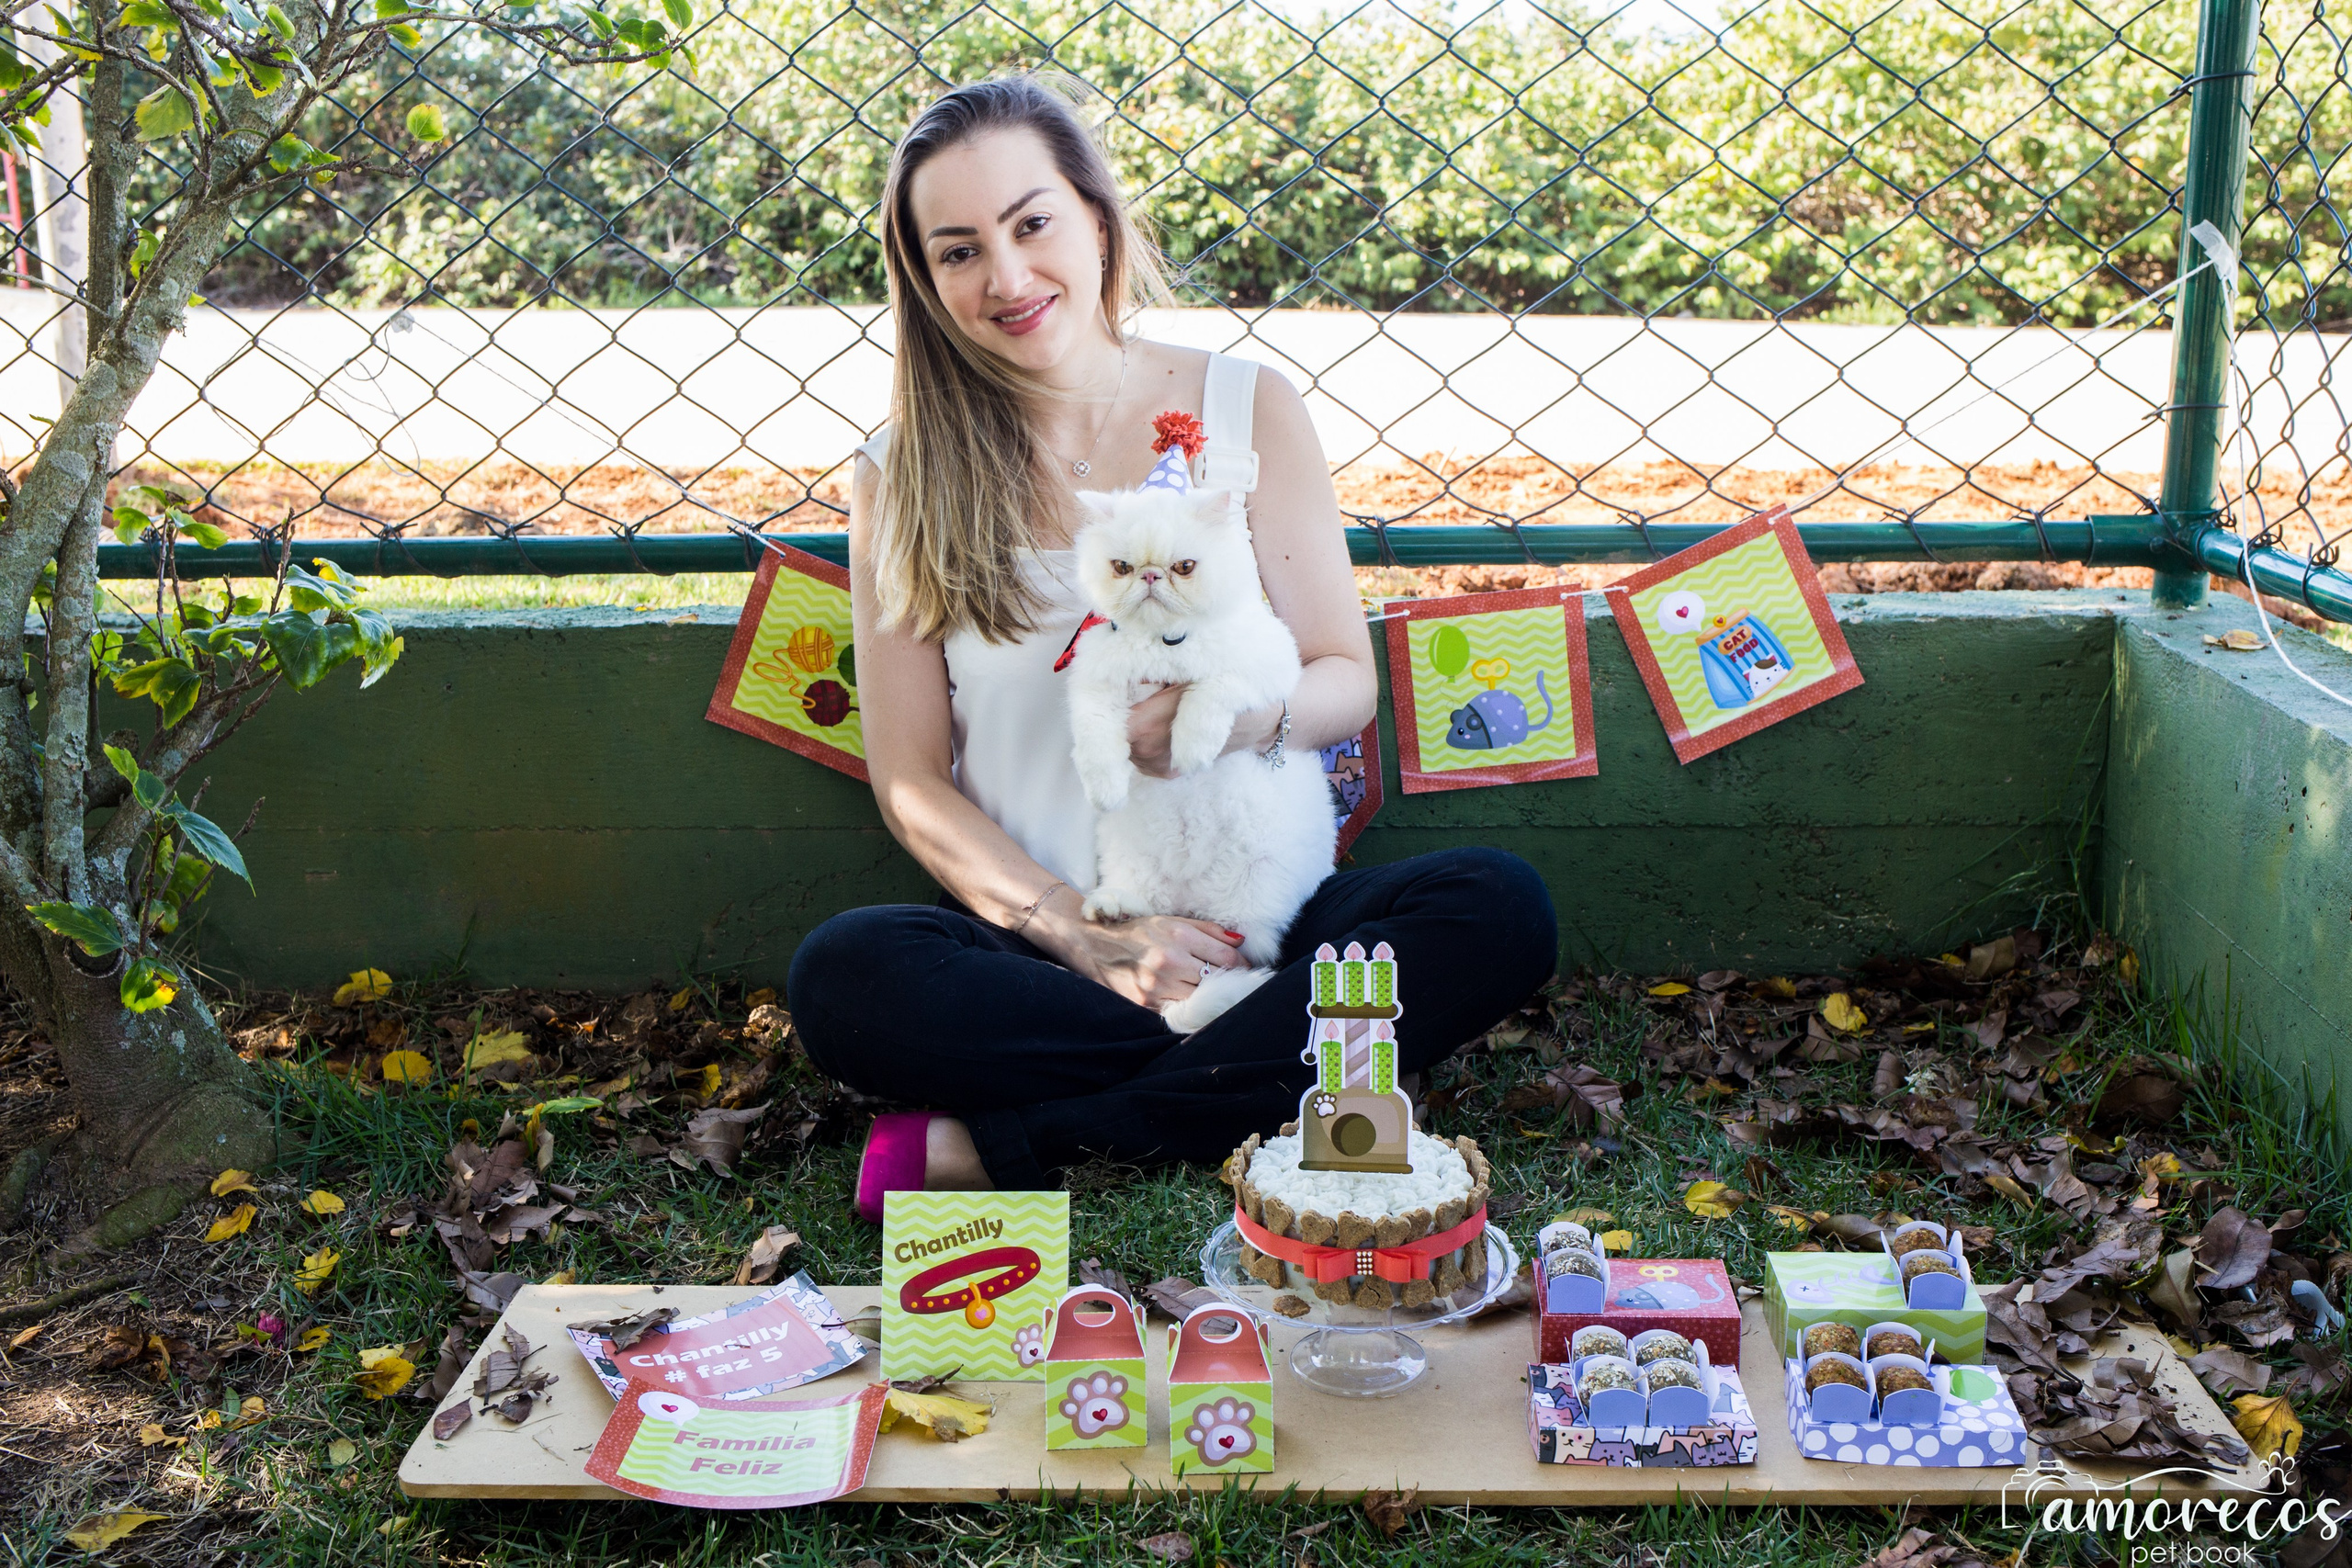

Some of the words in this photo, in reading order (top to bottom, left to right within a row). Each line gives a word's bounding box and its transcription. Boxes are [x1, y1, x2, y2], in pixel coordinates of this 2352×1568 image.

[1724, 629, 1747, 651] CAT
[1730, 638, 1759, 663] FOOD
[894, 1217, 1003, 1264] Chantilly
[629, 1320, 789, 1368] Chantilly
[664, 1370, 687, 1383] #
[695, 1358, 752, 1379] faz
[759, 1346, 784, 1363] 5
[689, 1457, 784, 1475] Feliz
